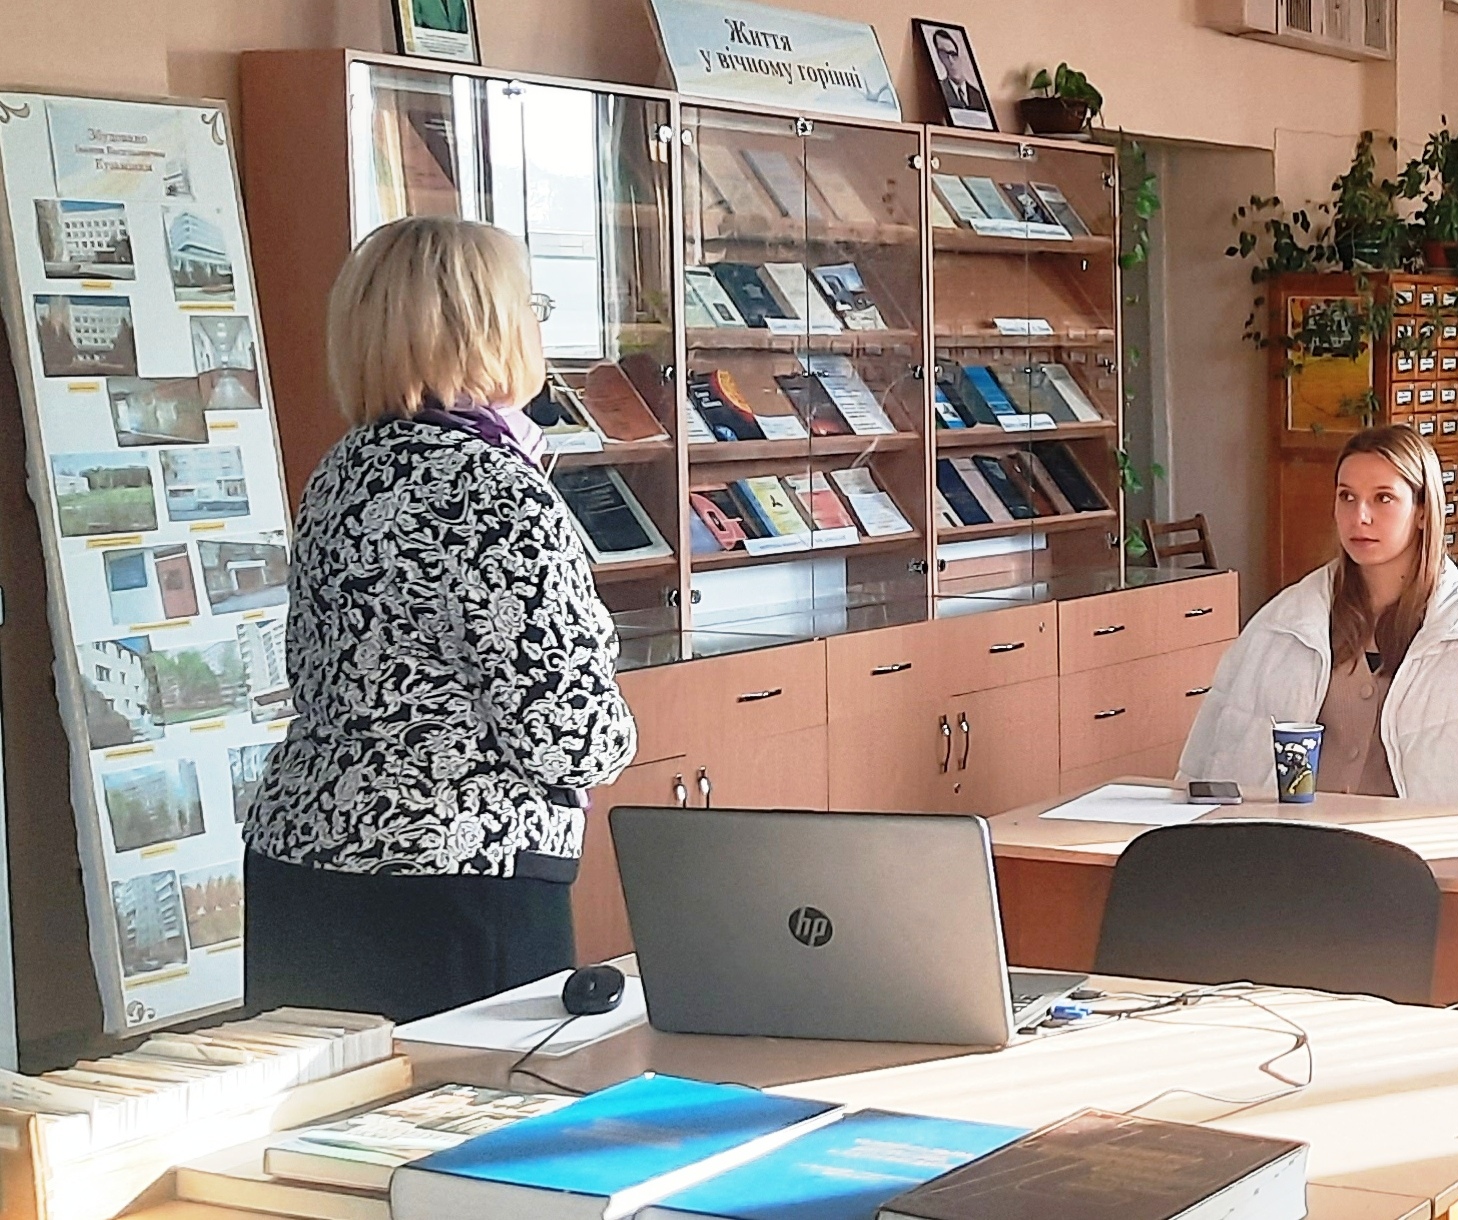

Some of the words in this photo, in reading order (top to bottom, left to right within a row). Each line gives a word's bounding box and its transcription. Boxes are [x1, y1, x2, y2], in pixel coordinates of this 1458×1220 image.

[724, 18, 793, 52] Життя
[699, 48, 712, 72] у
[716, 46, 793, 85] вічному
[797, 62, 863, 90] горінні
[793, 904, 830, 947] hp
